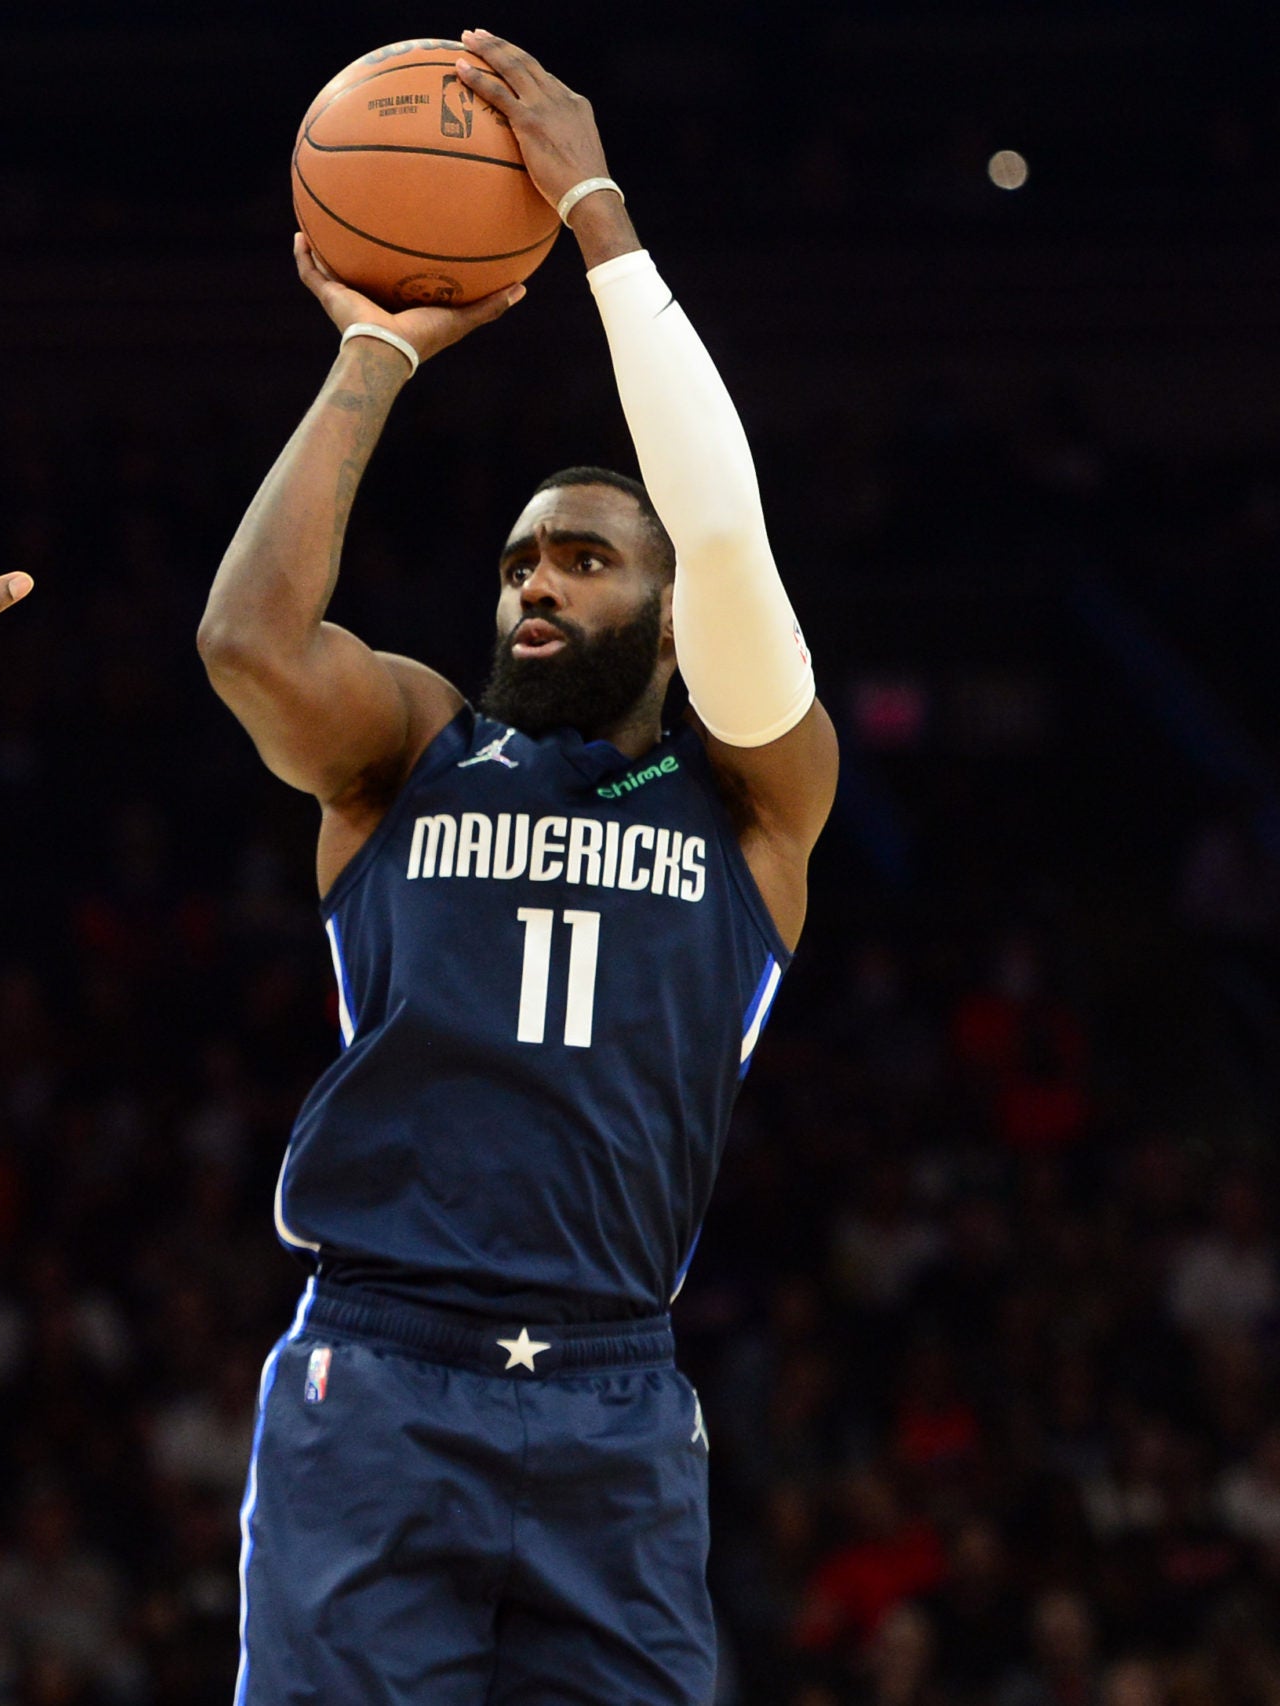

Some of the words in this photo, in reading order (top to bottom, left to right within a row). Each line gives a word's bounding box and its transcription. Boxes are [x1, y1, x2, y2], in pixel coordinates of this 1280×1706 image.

[597, 755, 679, 799] chime
[407, 812, 706, 903] MAVERICKS
[517, 907, 601, 1047] 11
